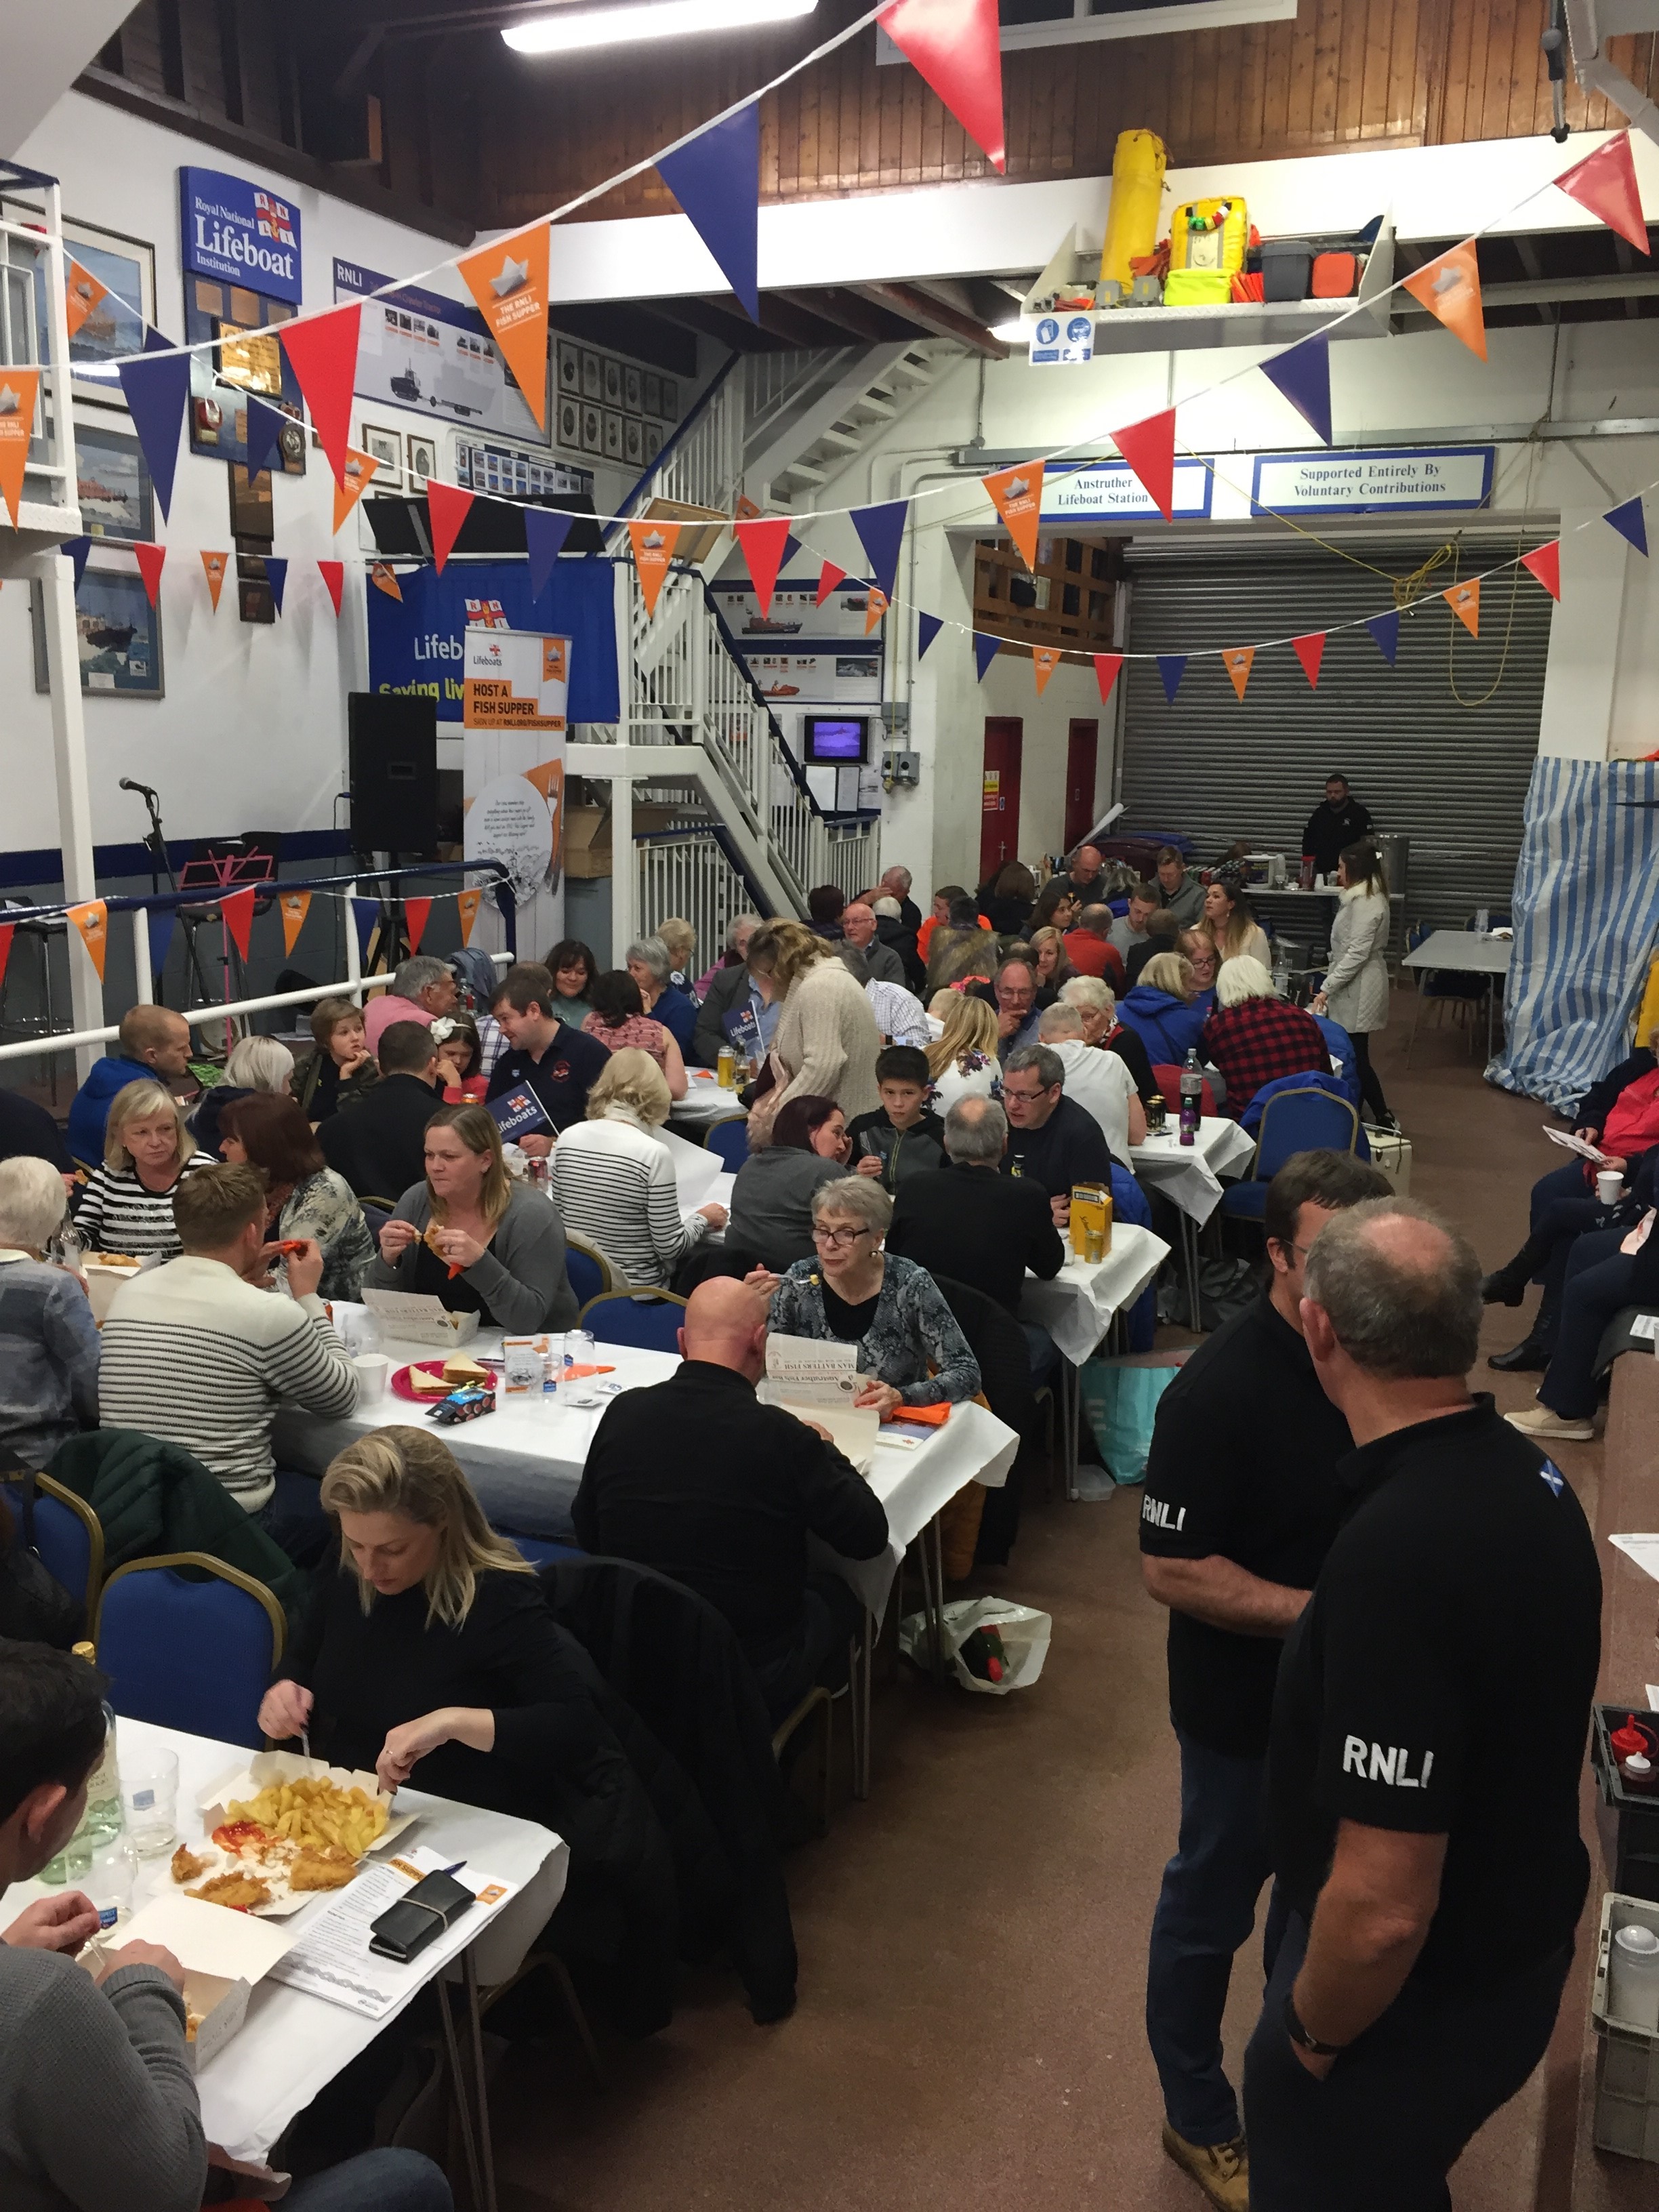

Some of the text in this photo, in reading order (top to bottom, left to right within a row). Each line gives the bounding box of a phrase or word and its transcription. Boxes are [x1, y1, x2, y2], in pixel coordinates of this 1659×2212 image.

[195, 197, 255, 229] Royal National
[194, 213, 294, 280] Lifeboat
[197, 251, 241, 277] Institution
[337, 263, 363, 287] RNLI
[500, 294, 532, 314] THE RNLI
[496, 302, 541, 327] FISH SUPPER
[1300, 464, 1441, 481] Supported Entirely By
[1074, 476, 1132, 489] Anstruther
[1294, 480, 1446, 497] Voluntary Contributions
[1058, 491, 1148, 506] Lifeboat Station
[474, 655, 502, 666] Lifeboats
[474, 684, 508, 697] HOST A
[474, 701, 534, 716] FISH SUPPER
[474, 718, 487, 726] SIGN
[729, 1021, 756, 1037] Lifeboats
[498, 1105, 537, 1133] ifeboats
[1142, 1494, 1187, 1532] RNLI
[1343, 1734, 1435, 1789] RNLI
